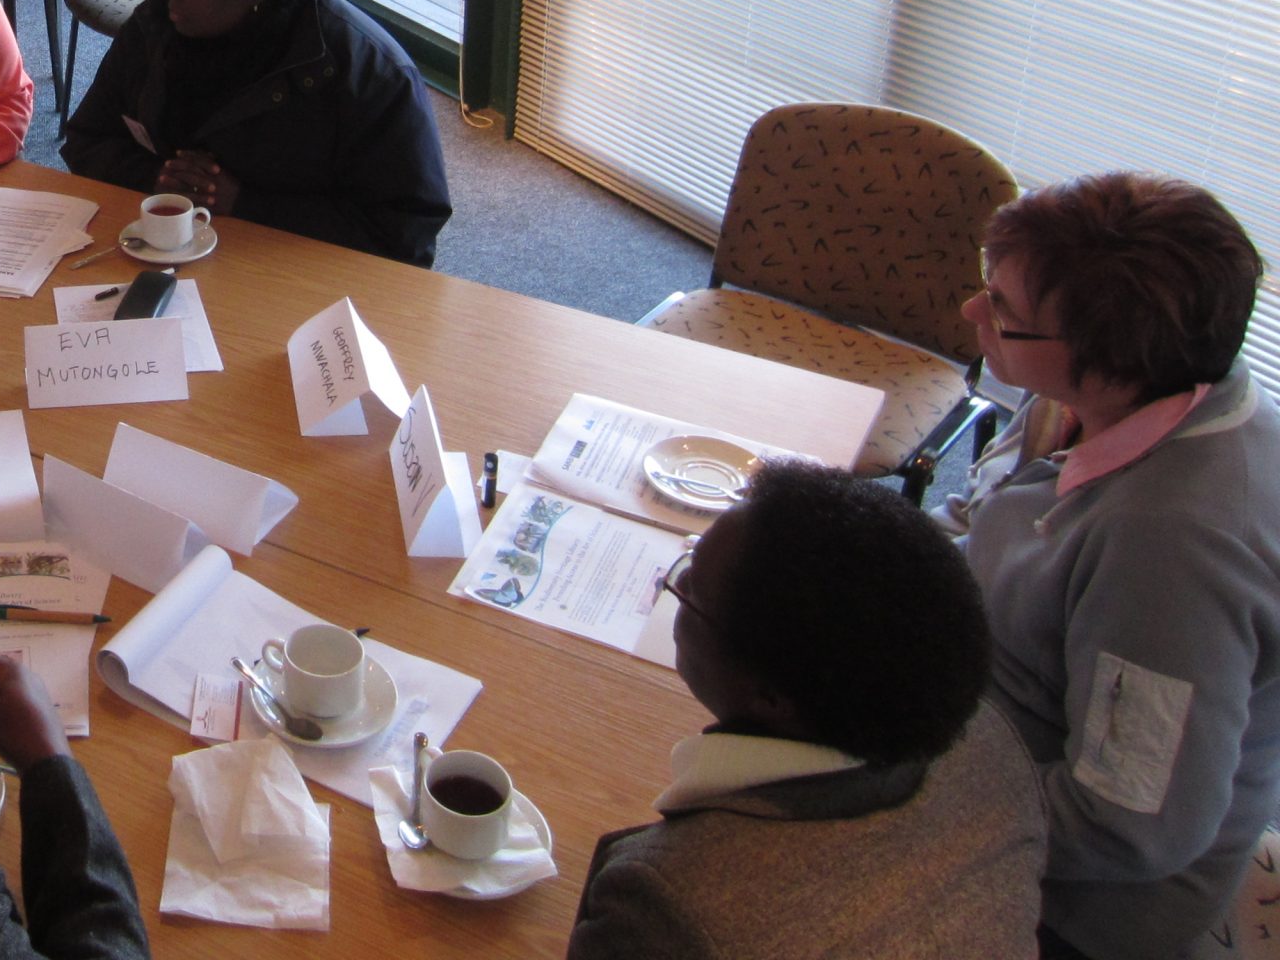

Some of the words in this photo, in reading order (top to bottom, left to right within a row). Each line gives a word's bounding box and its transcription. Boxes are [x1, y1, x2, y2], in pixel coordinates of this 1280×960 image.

[58, 327, 111, 352] EVA
[333, 326, 355, 381] GEOFFREY
[36, 361, 159, 387] MUTONGOLE
[310, 340, 337, 407] MWACHALA
